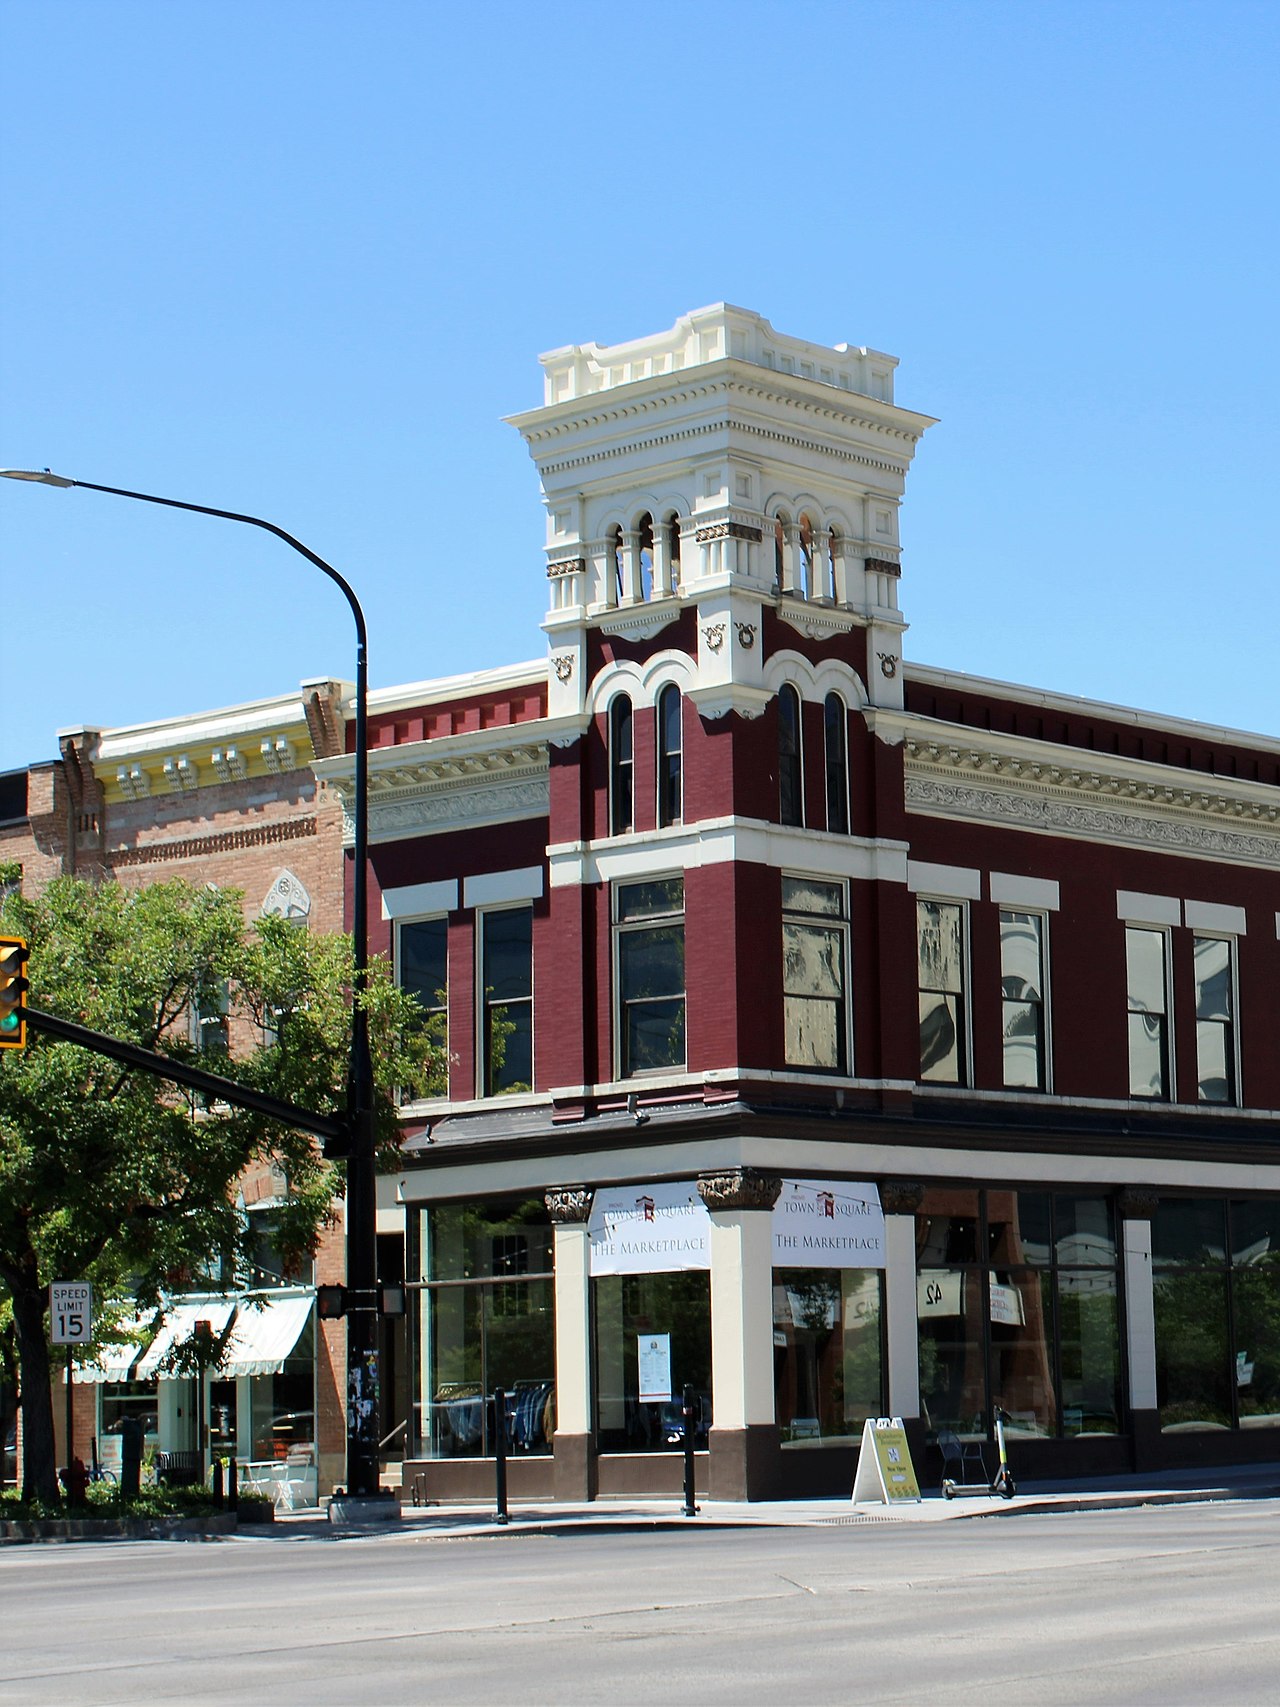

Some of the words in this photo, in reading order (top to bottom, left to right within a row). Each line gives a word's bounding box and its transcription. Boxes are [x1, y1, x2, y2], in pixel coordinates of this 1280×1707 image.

[601, 1209, 635, 1222] TOWN
[655, 1204, 695, 1219] SQUARE
[784, 1201, 815, 1213] TOWN
[835, 1204, 872, 1217] SQUARE
[592, 1242, 616, 1257] THE
[620, 1238, 705, 1254] MARKETPLACE
[775, 1234, 798, 1248] THE
[803, 1235, 880, 1250] MARKETPLACE
[54, 1289, 88, 1299] SPEED
[57, 1301, 83, 1311] LIMIT
[59, 1314, 83, 1336] 15
